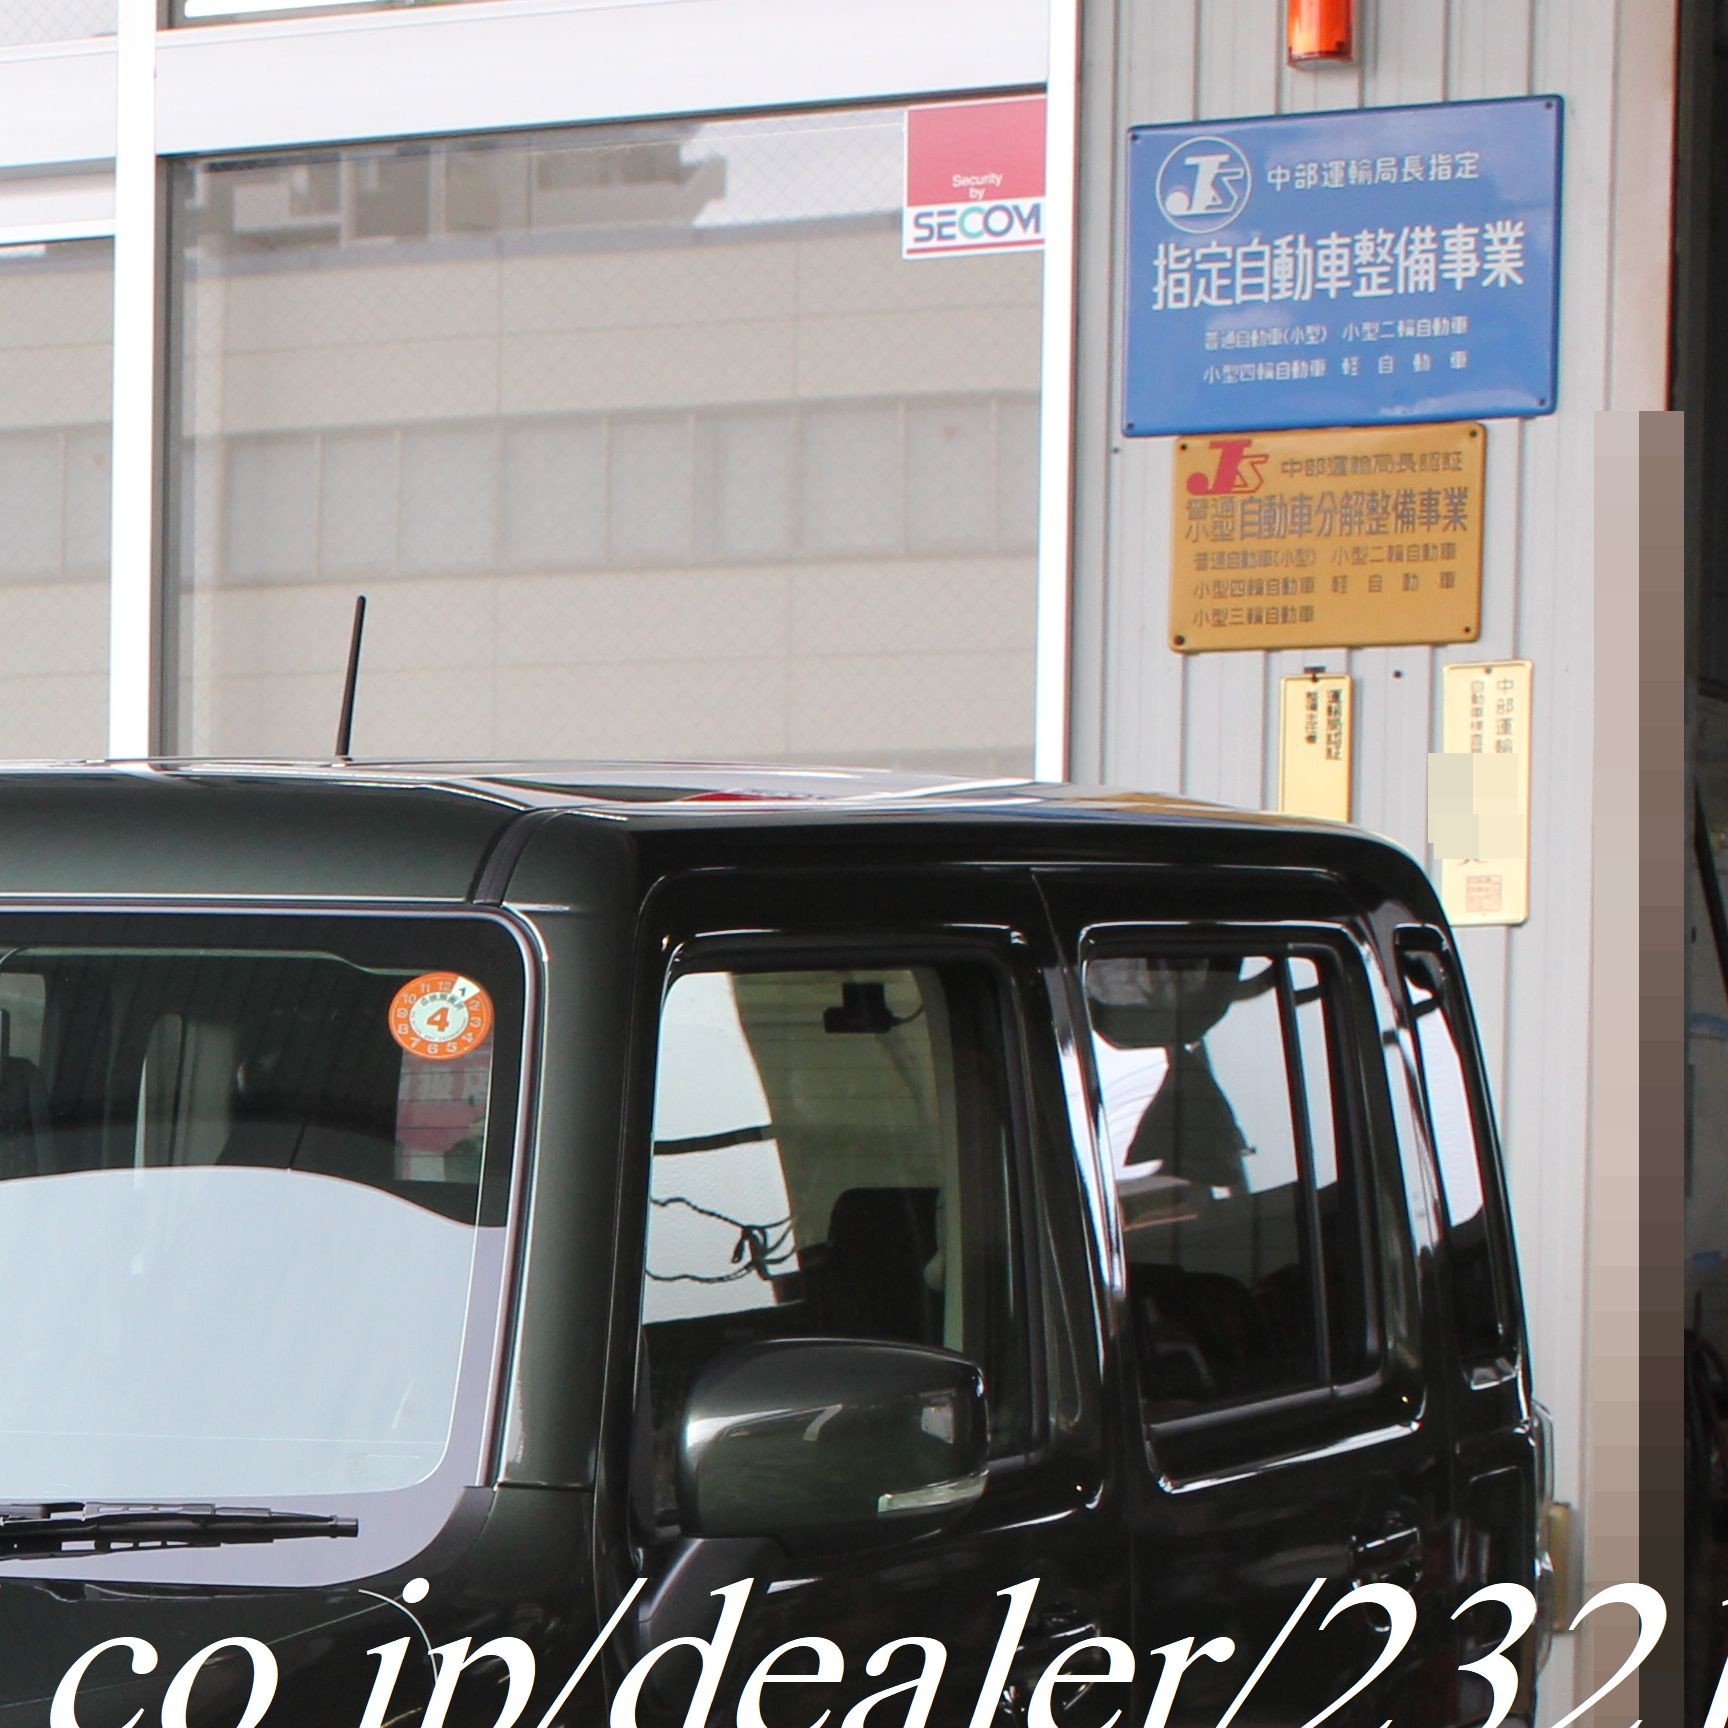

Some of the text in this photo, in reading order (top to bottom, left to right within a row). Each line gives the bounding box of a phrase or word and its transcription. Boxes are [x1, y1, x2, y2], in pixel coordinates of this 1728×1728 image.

[951, 172, 1004, 188] Security
[1267, 151, 1480, 192] 中部運輸局長指定
[968, 187, 986, 201] by
[913, 202, 1042, 243] SECOM
[1151, 219, 1526, 311] 指定自動車整備事業
[426, 1006, 449, 1033] 4
